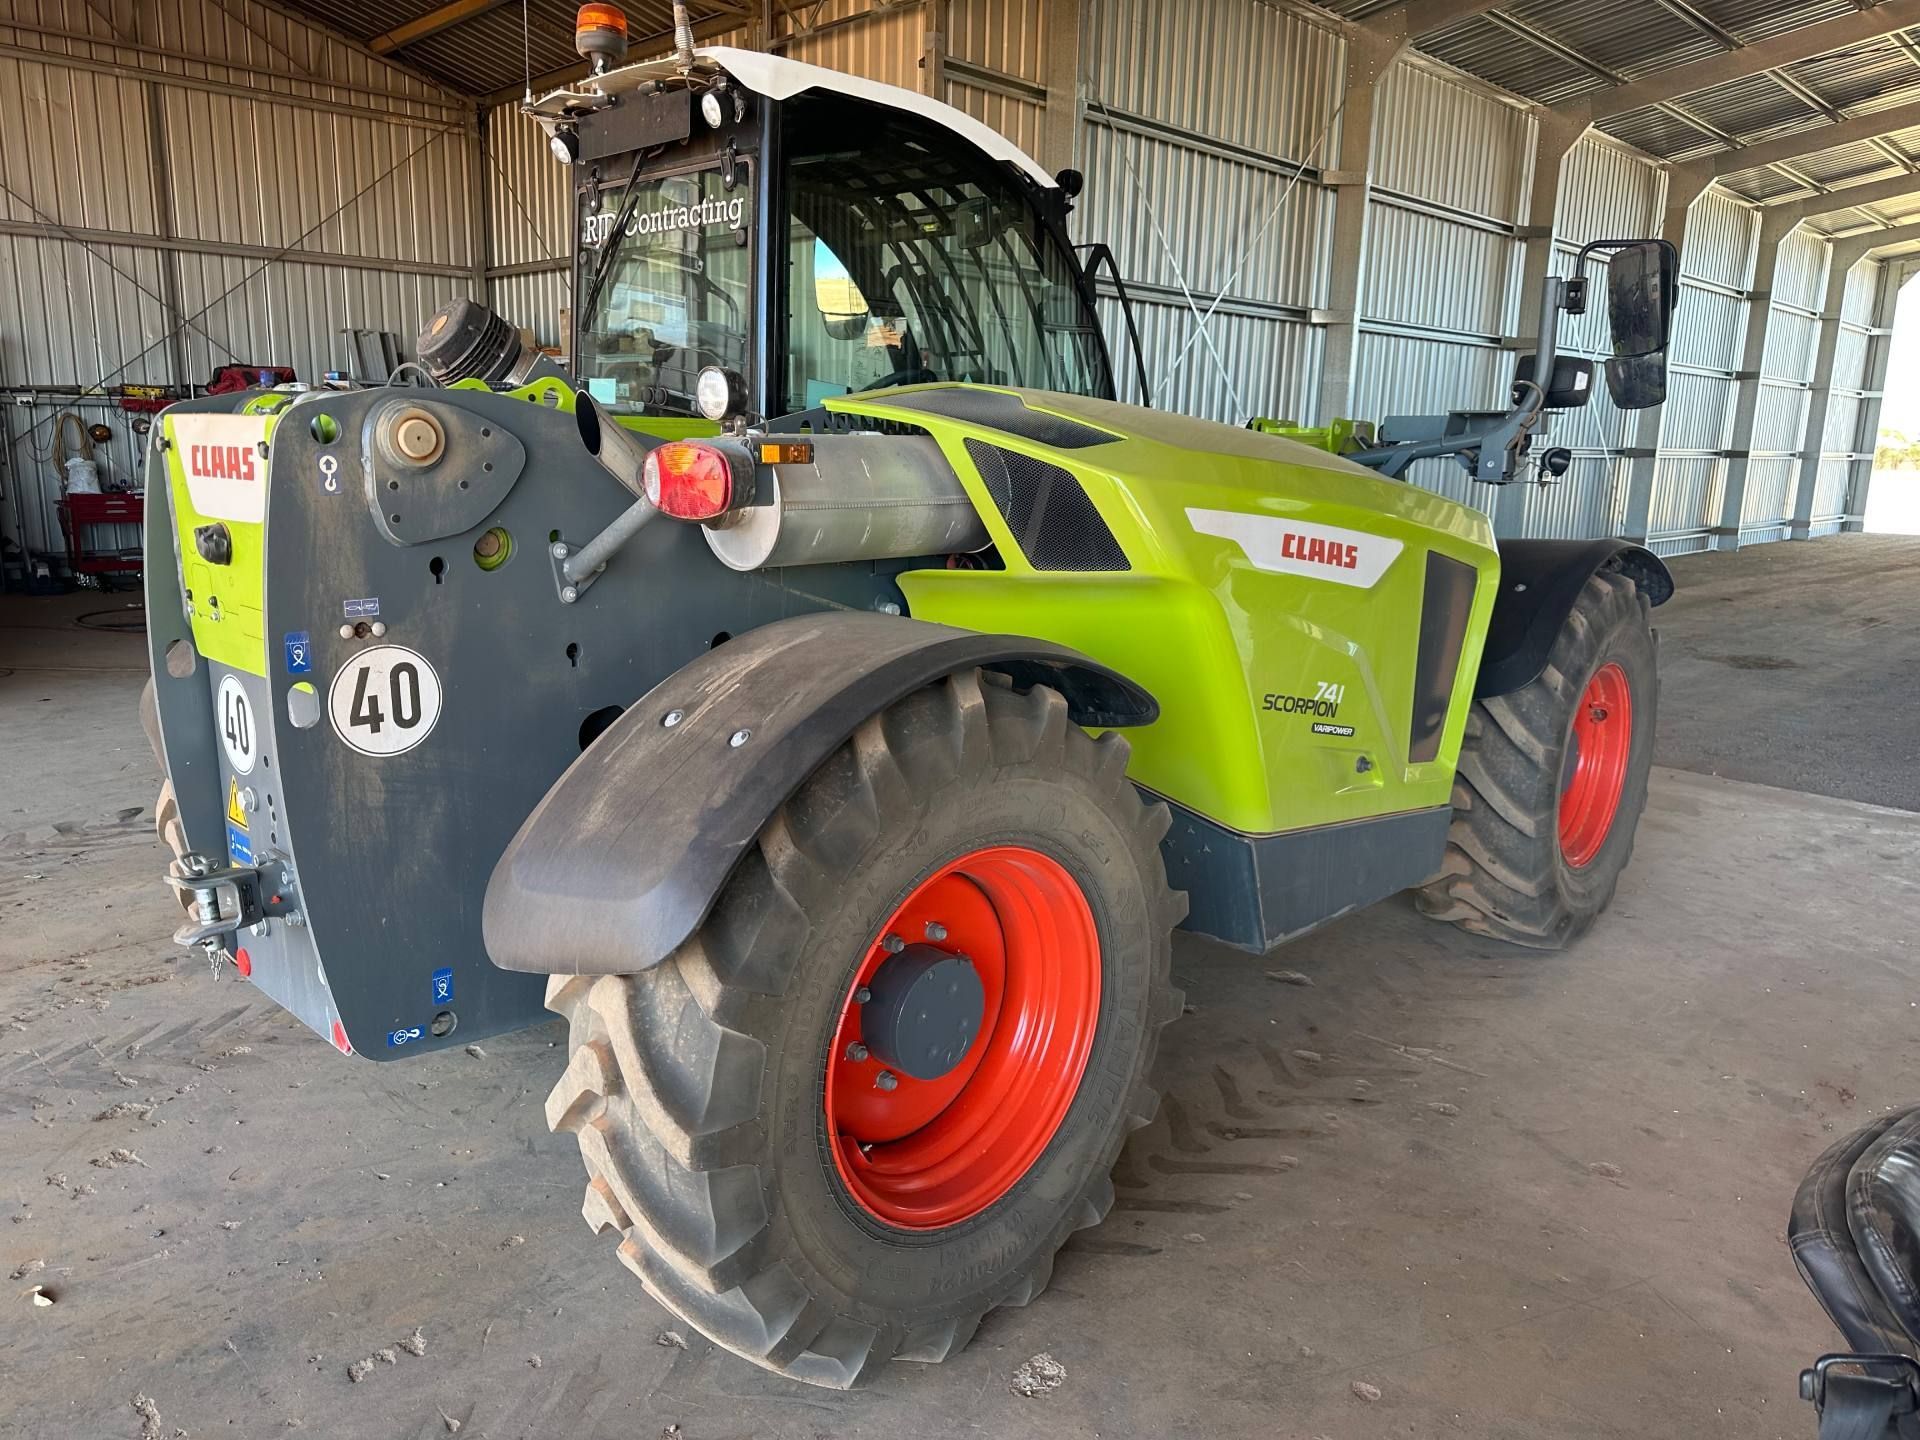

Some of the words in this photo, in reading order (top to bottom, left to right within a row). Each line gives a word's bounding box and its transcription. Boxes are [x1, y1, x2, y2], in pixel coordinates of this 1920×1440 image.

[625, 195, 743, 237] Contracting
[191, 444, 255, 481] CLAAS
[1281, 533, 1358, 569] CLAAS
[350, 662, 422, 735] 40
[1262, 693, 1338, 718] SCORPION
[1314, 681, 1345, 704] 741
[225, 690, 250, 756] 40
[1313, 723, 1353, 736] VARIPOWER
